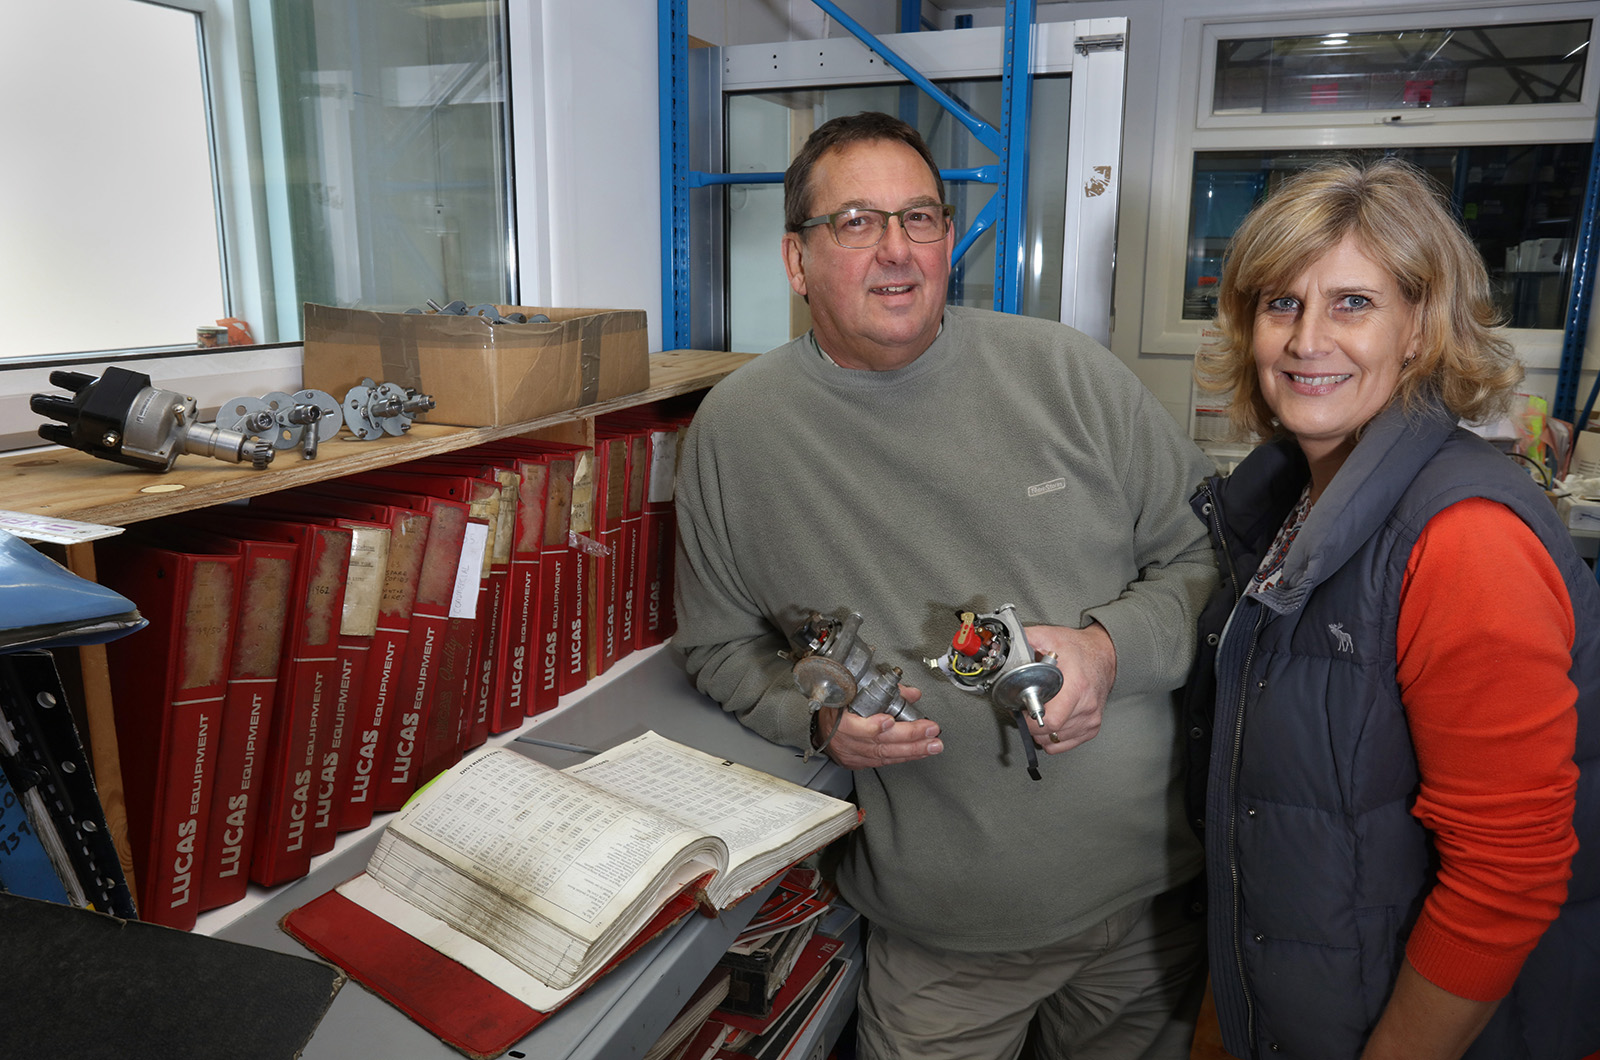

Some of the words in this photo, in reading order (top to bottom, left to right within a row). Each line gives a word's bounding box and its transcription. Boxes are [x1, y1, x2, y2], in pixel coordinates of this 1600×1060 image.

[439, 635, 464, 682] Quality
[477, 659, 492, 724] LUCAS
[488, 582, 500, 656] EQUIPMENT
[510, 645, 525, 707] LUCAS
[520, 571, 532, 643] EQUIPMENT
[544, 632, 557, 690] LUCAS
[552, 560, 562, 629] EQUIPMENT
[571, 618, 582, 674] LUCAS
[606, 604, 615, 658] LUCAS
[623, 590, 633, 641] LUCAS
[648, 581, 661, 630] LUCAS
[287, 769, 312, 852] LUCAS
[305, 672, 324, 766] EQUIPMENT
[314, 751, 339, 828] LUCAS
[332, 659, 353, 749] EQUIPMENT
[350, 729, 379, 803] LUCAS
[373, 641, 396, 726] EQUIPMENT
[391, 712, 419, 783] LUCAS
[413, 626, 436, 710] EQUIPMENT
[459, 750, 502, 775] DISTRIBUTORS
[170, 818, 197, 908] LUCAS
[190, 713, 209, 815] EQUIPMENT
[219, 793, 249, 878] LUCAS
[241, 694, 262, 790] EQUIPMENT
